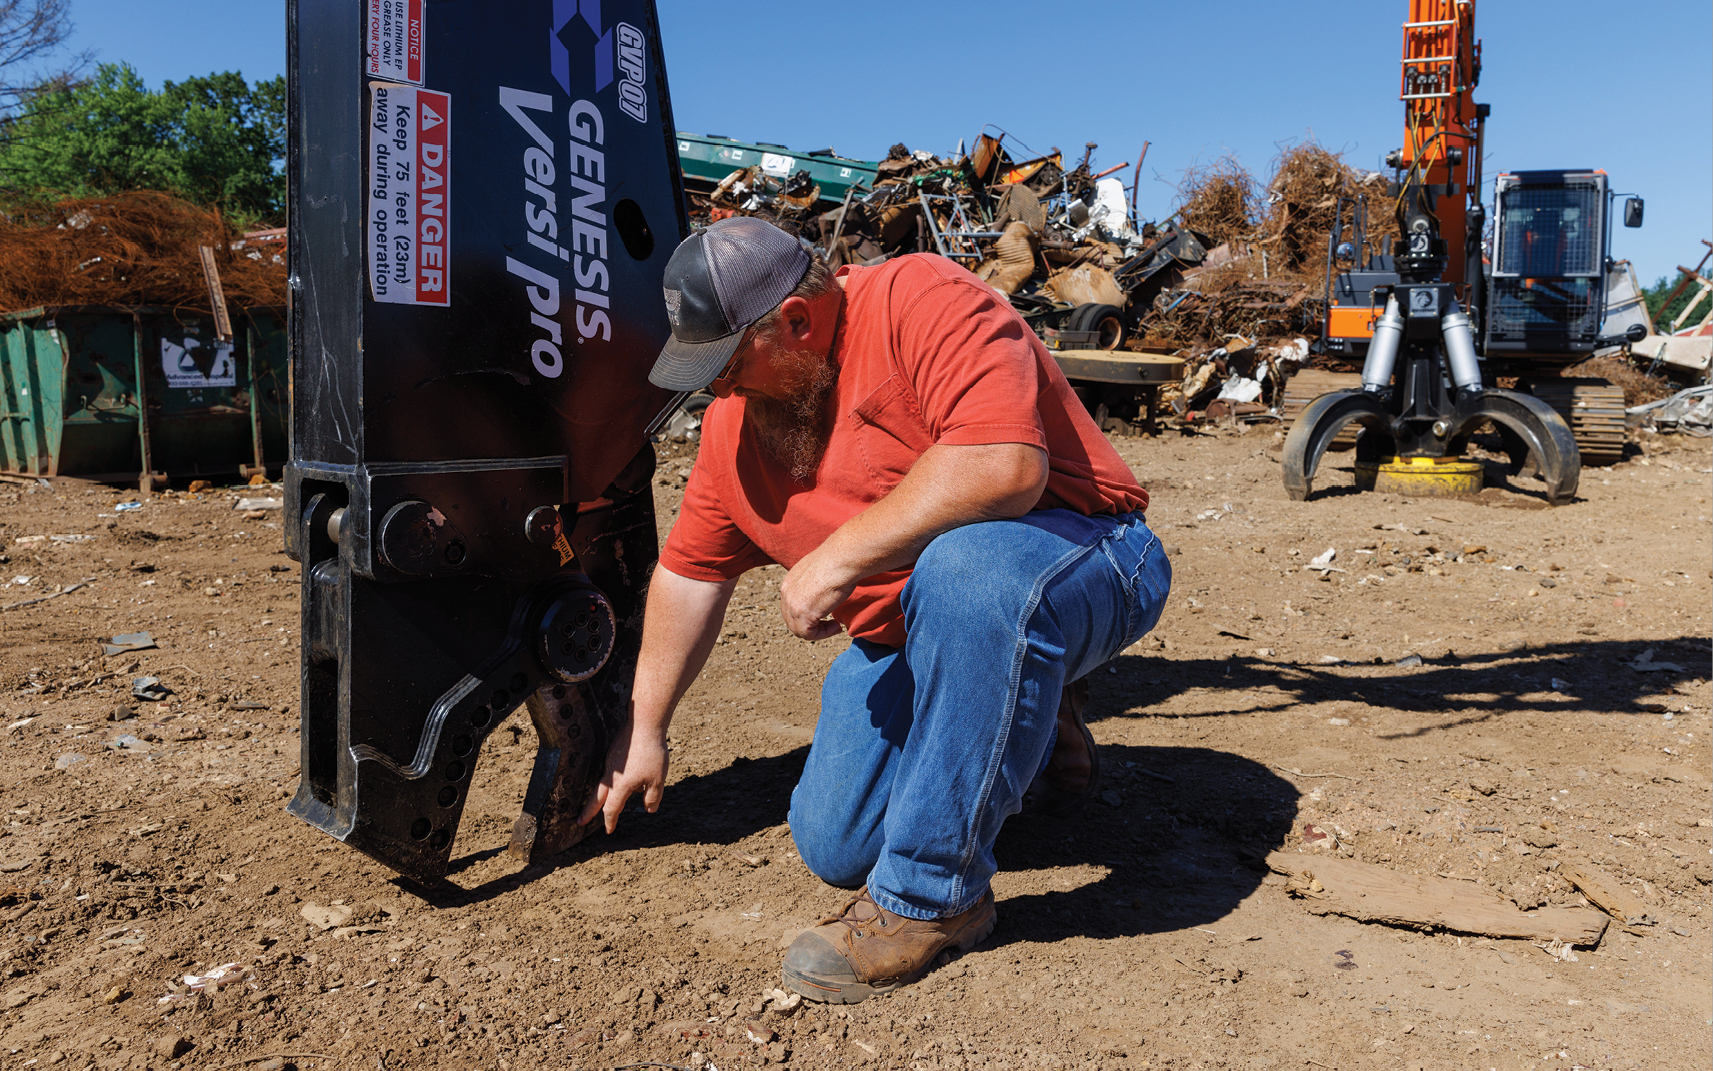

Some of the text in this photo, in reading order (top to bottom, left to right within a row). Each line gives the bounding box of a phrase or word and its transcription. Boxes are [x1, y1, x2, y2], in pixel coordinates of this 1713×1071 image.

[371, 0, 379, 73] ERY FOUR HOURS
[383, 1, 391, 66] GREASE ONLY
[395, 2, 403, 70] USE LITHIUM EP
[410, 19, 419, 60] NOTICE
[372, 87, 391, 295] away during operation
[393, 105, 411, 284] Keep 75 feet (23m)
[421, 142, 443, 291] DANGER
[499, 86, 569, 262] Versi
[568, 99, 612, 342] GENESIS
